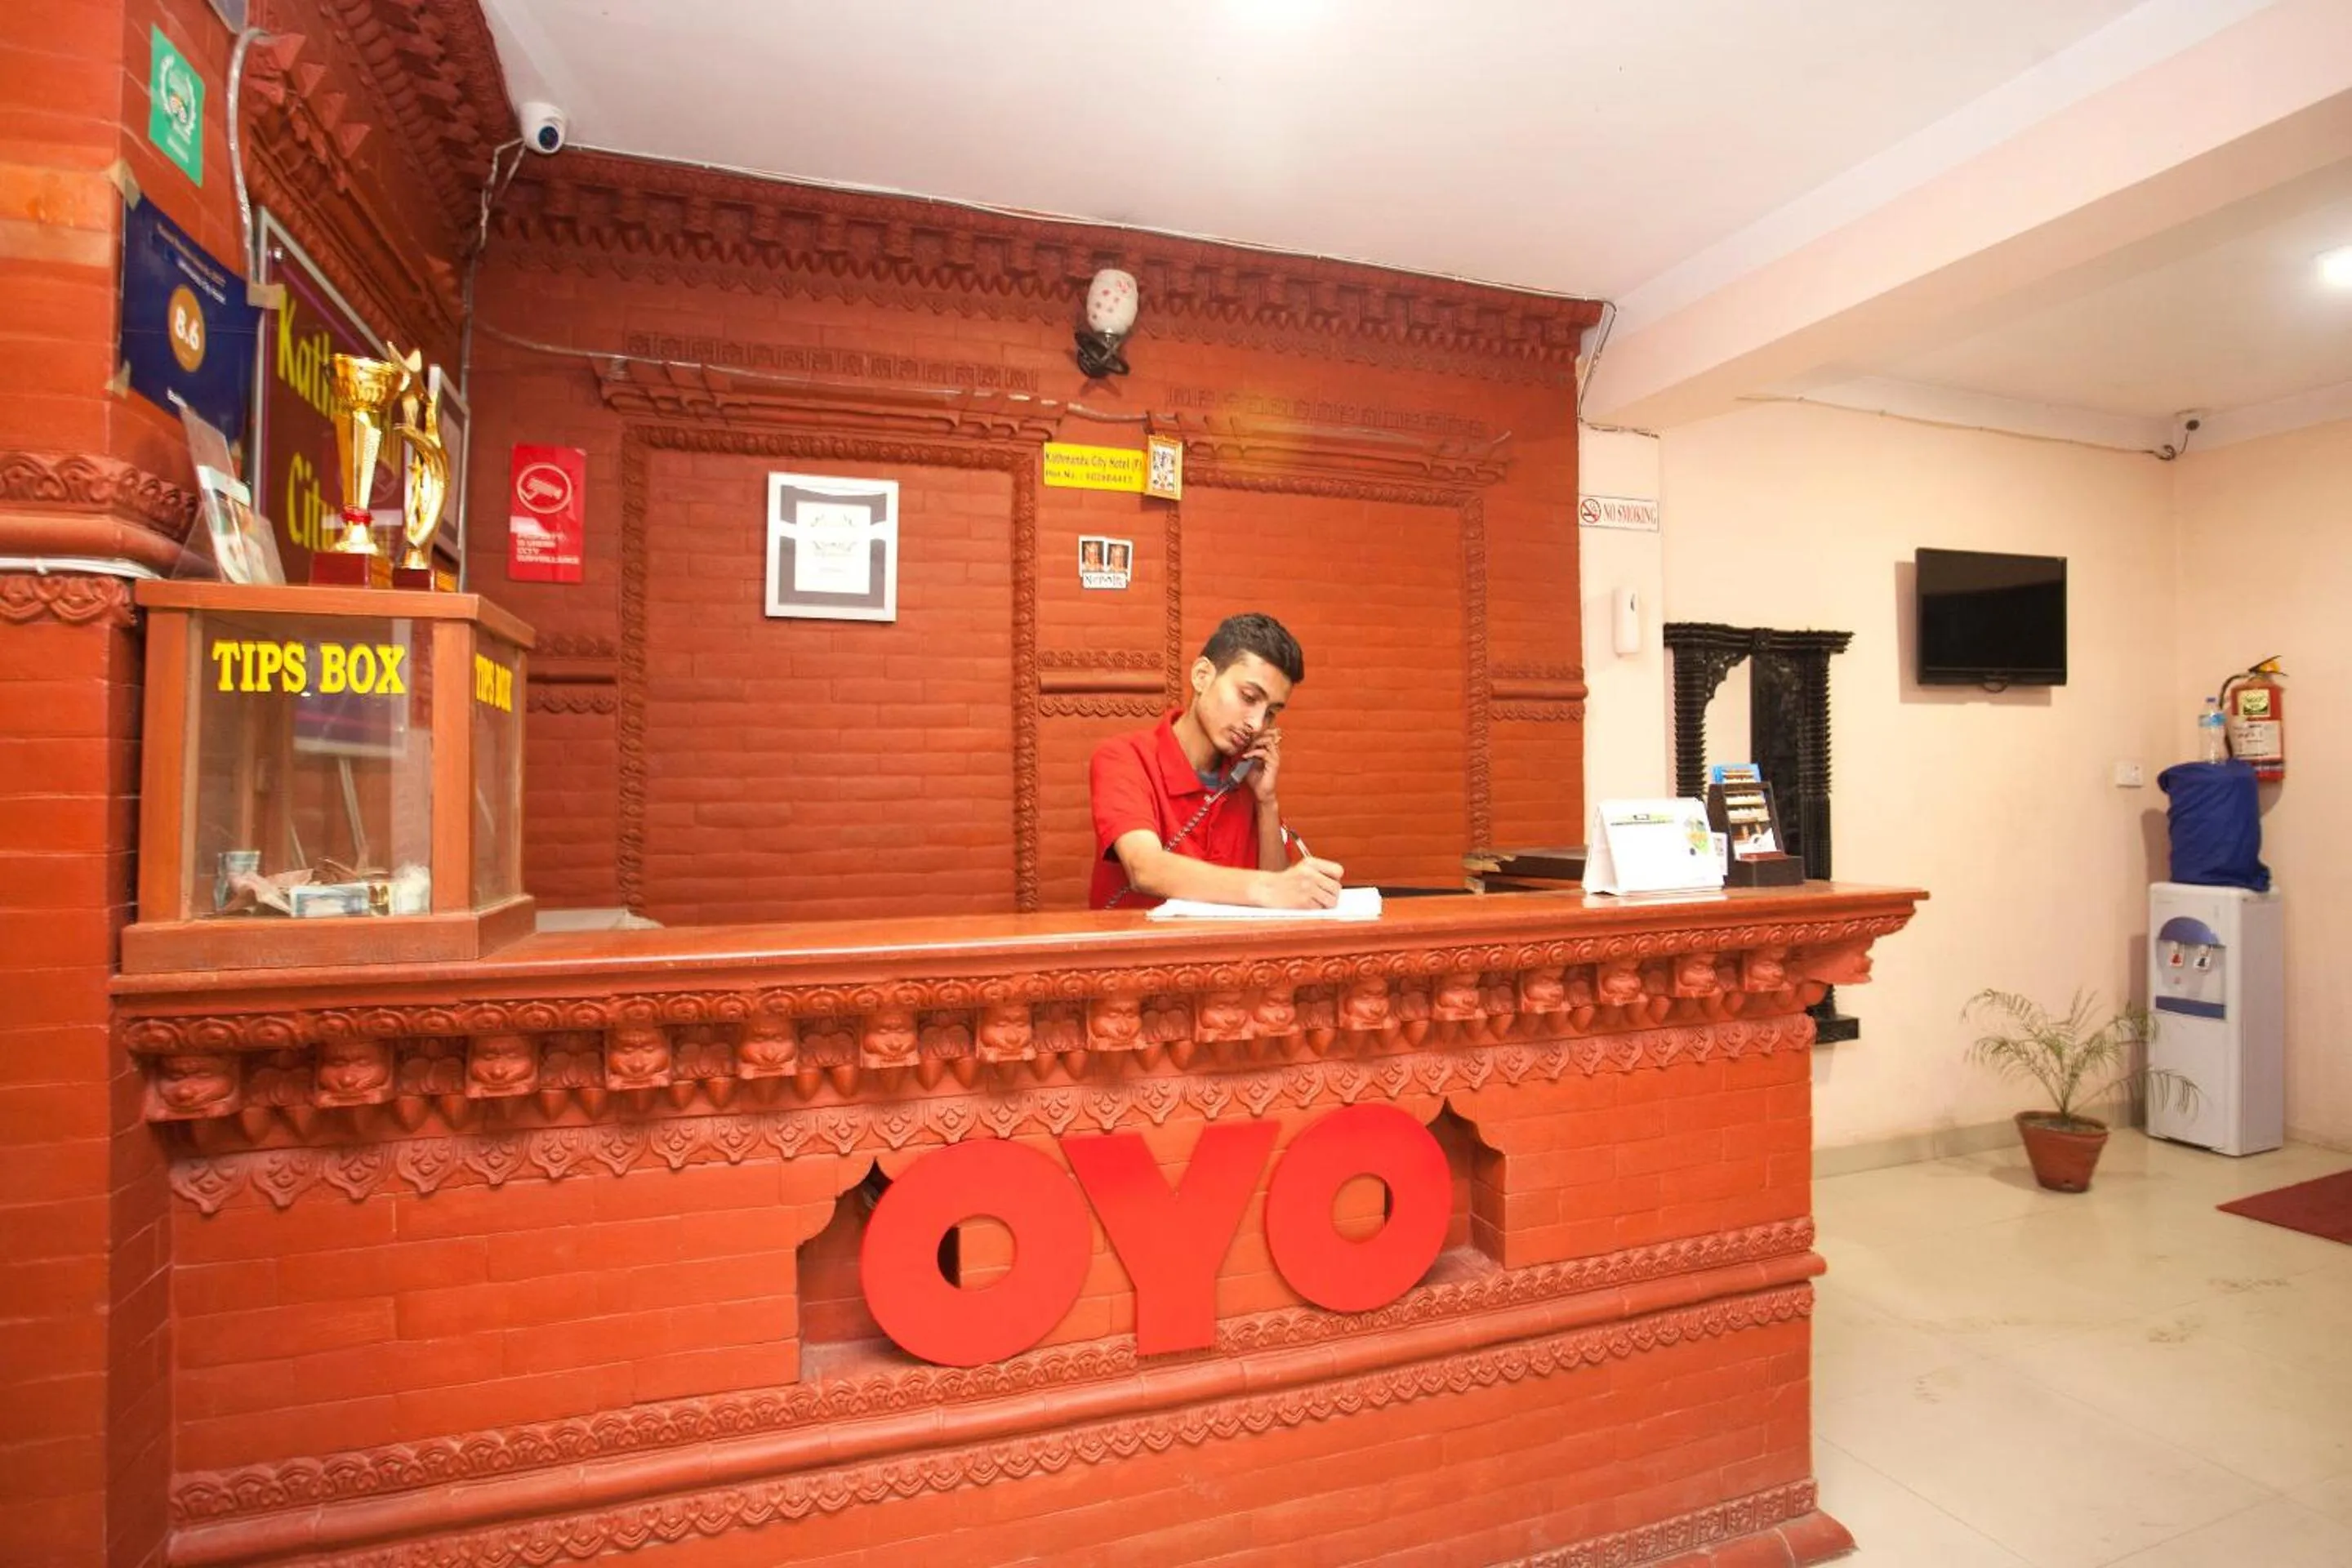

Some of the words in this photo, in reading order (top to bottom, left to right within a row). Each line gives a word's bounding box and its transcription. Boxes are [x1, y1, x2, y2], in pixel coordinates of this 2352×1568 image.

[176, 305, 199, 350] 8.6
[1603, 502, 1616, 522] NO
[1617, 504, 1657, 524] SMOKING
[212, 639, 307, 693] TIPS
[319, 643, 407, 694] BOX
[475, 653, 494, 706] TIPS
[495, 662, 512, 712] BOX
[860, 1102, 1453, 1367] OYO
